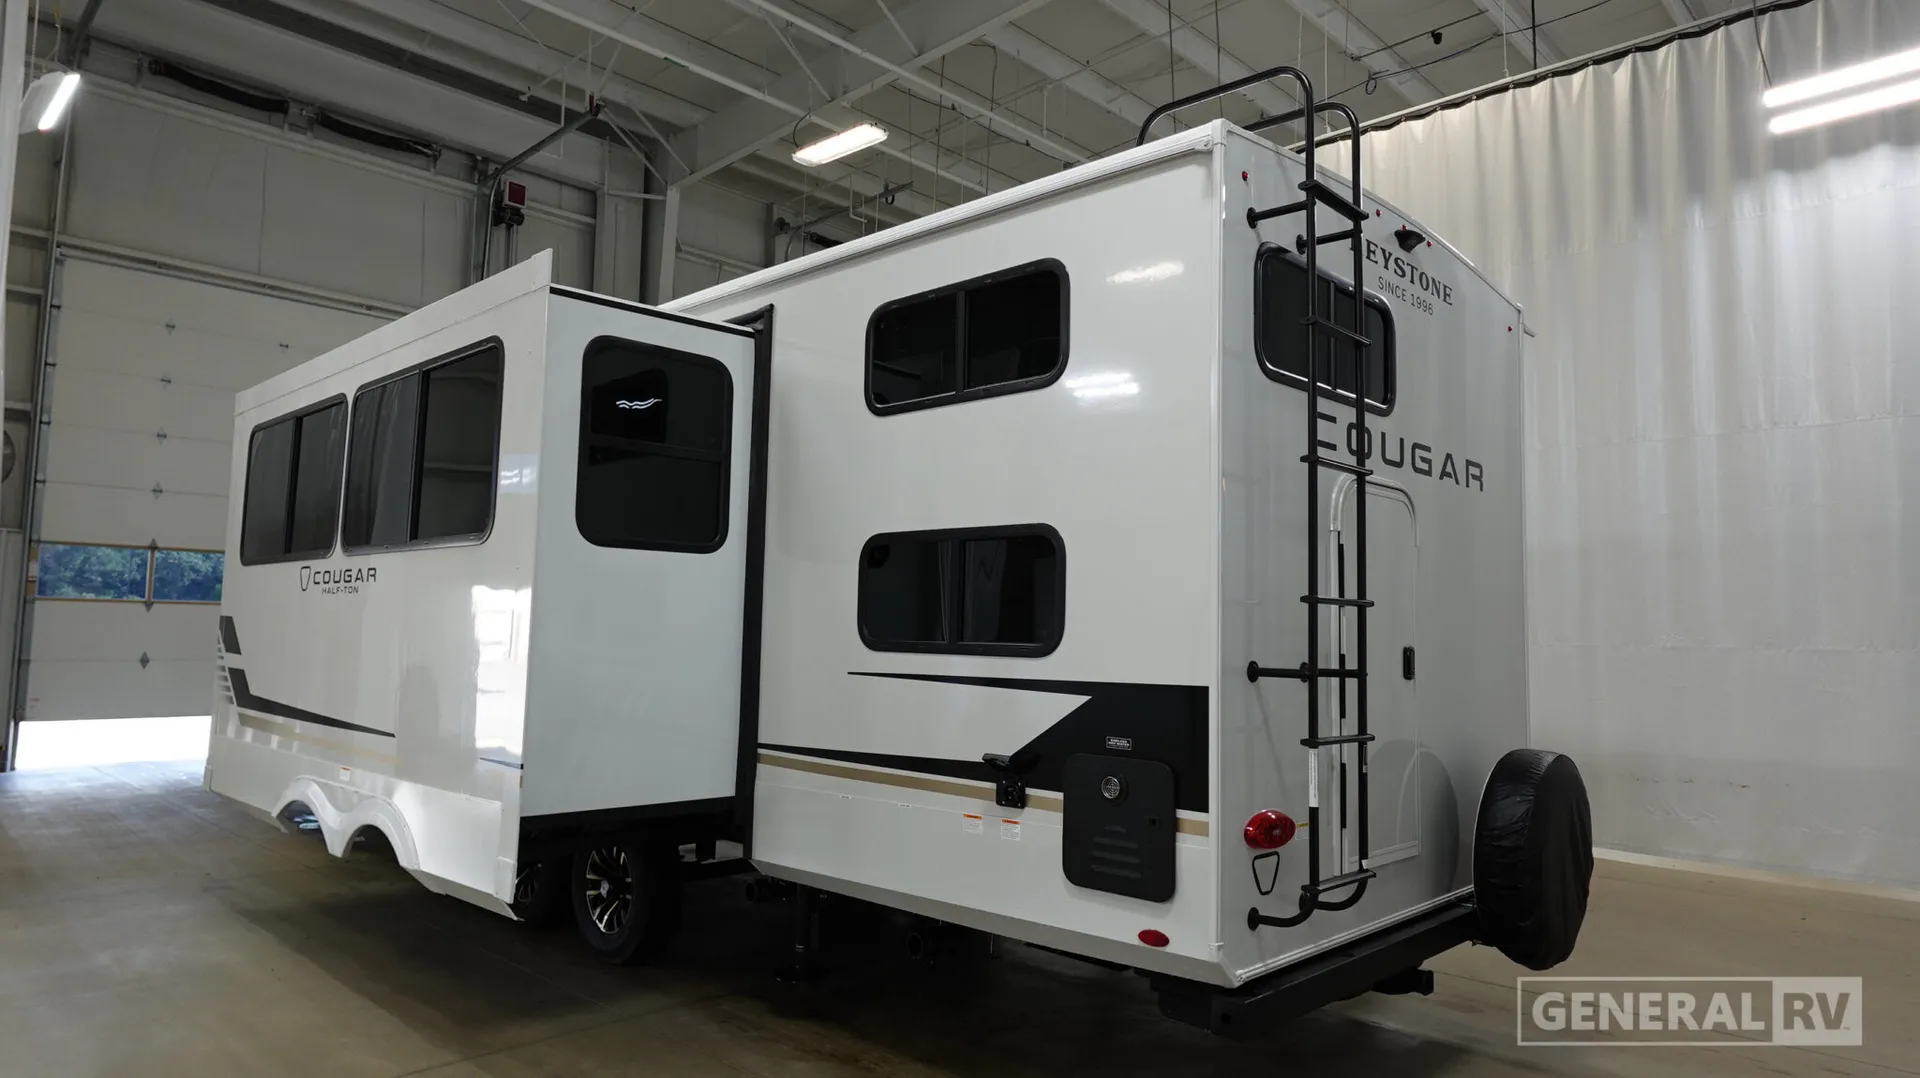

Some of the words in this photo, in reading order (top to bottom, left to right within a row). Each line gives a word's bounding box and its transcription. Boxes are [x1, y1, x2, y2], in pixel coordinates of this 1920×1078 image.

[1350, 238, 1453, 306] EYSTONE
[1378, 276, 1407, 302] SINCE
[1410, 293, 1434, 316] 1996
[313, 567, 377, 585] COUGAR
[322, 586, 359, 594] HALF-TON
